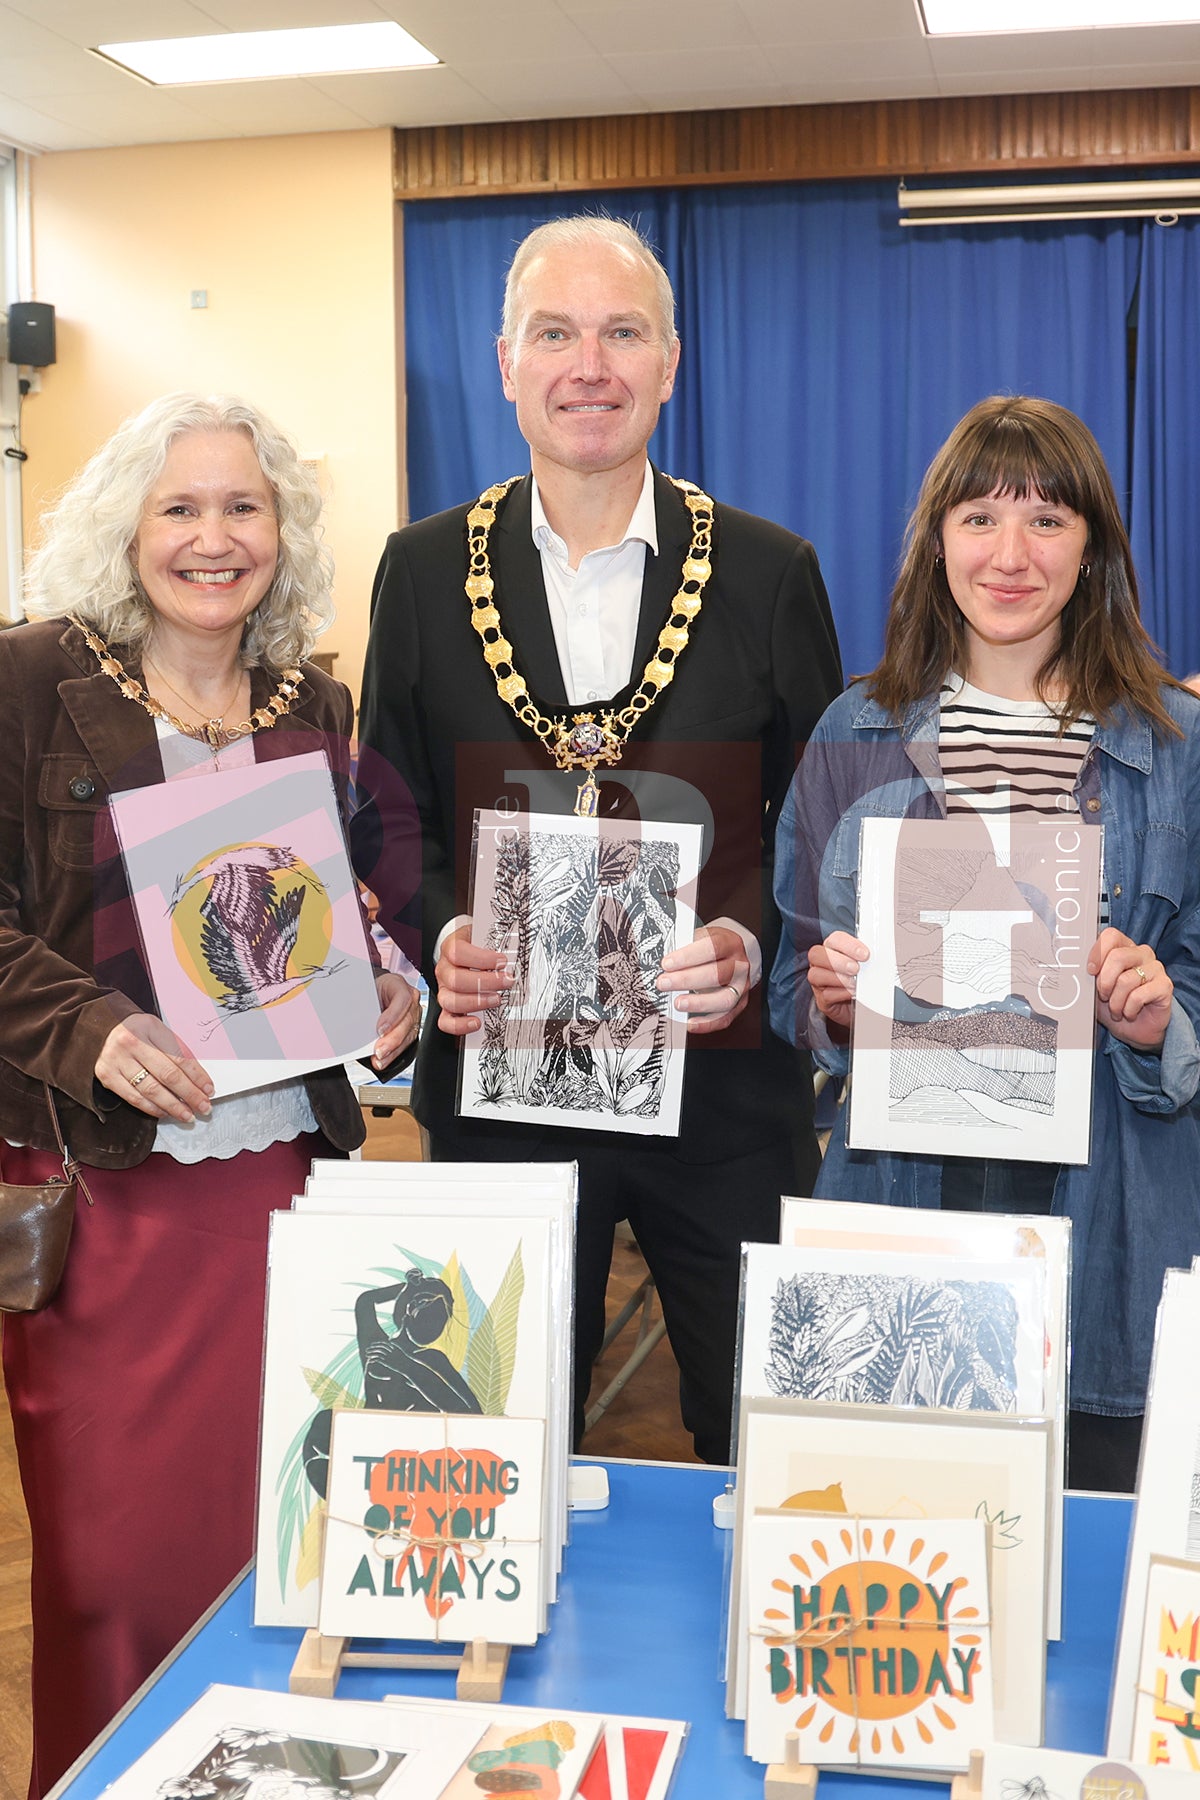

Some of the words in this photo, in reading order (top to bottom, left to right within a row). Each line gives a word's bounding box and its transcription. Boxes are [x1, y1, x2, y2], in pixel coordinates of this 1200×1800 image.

[352, 1455, 520, 1495] THINKING
[363, 1503, 412, 1540] OF
[345, 1554, 521, 1602] ALWAYS
[792, 1582, 955, 1631] HAPPY
[769, 1647, 981, 1698] BIRTHDAY
